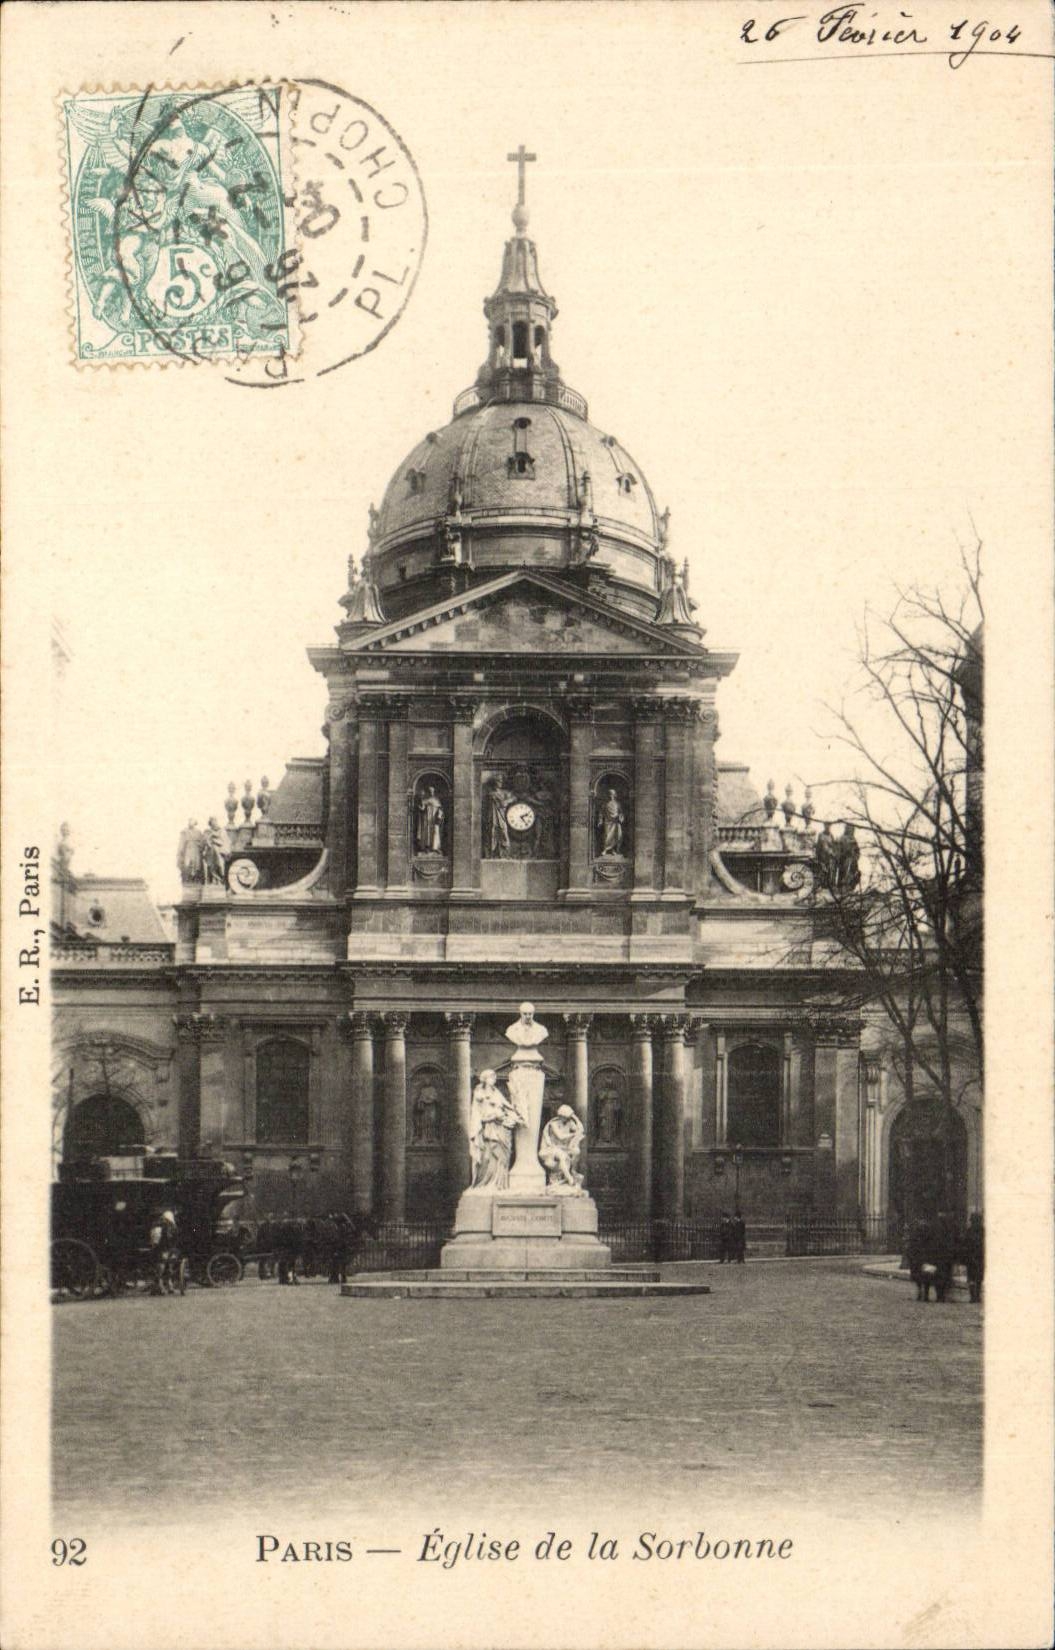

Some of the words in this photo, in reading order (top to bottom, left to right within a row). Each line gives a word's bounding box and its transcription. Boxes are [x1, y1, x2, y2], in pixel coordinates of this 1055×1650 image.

[740, 16, 807, 43] 26
[949, 20, 1022, 69] 1904
[137, 327, 230, 353] POSTES
